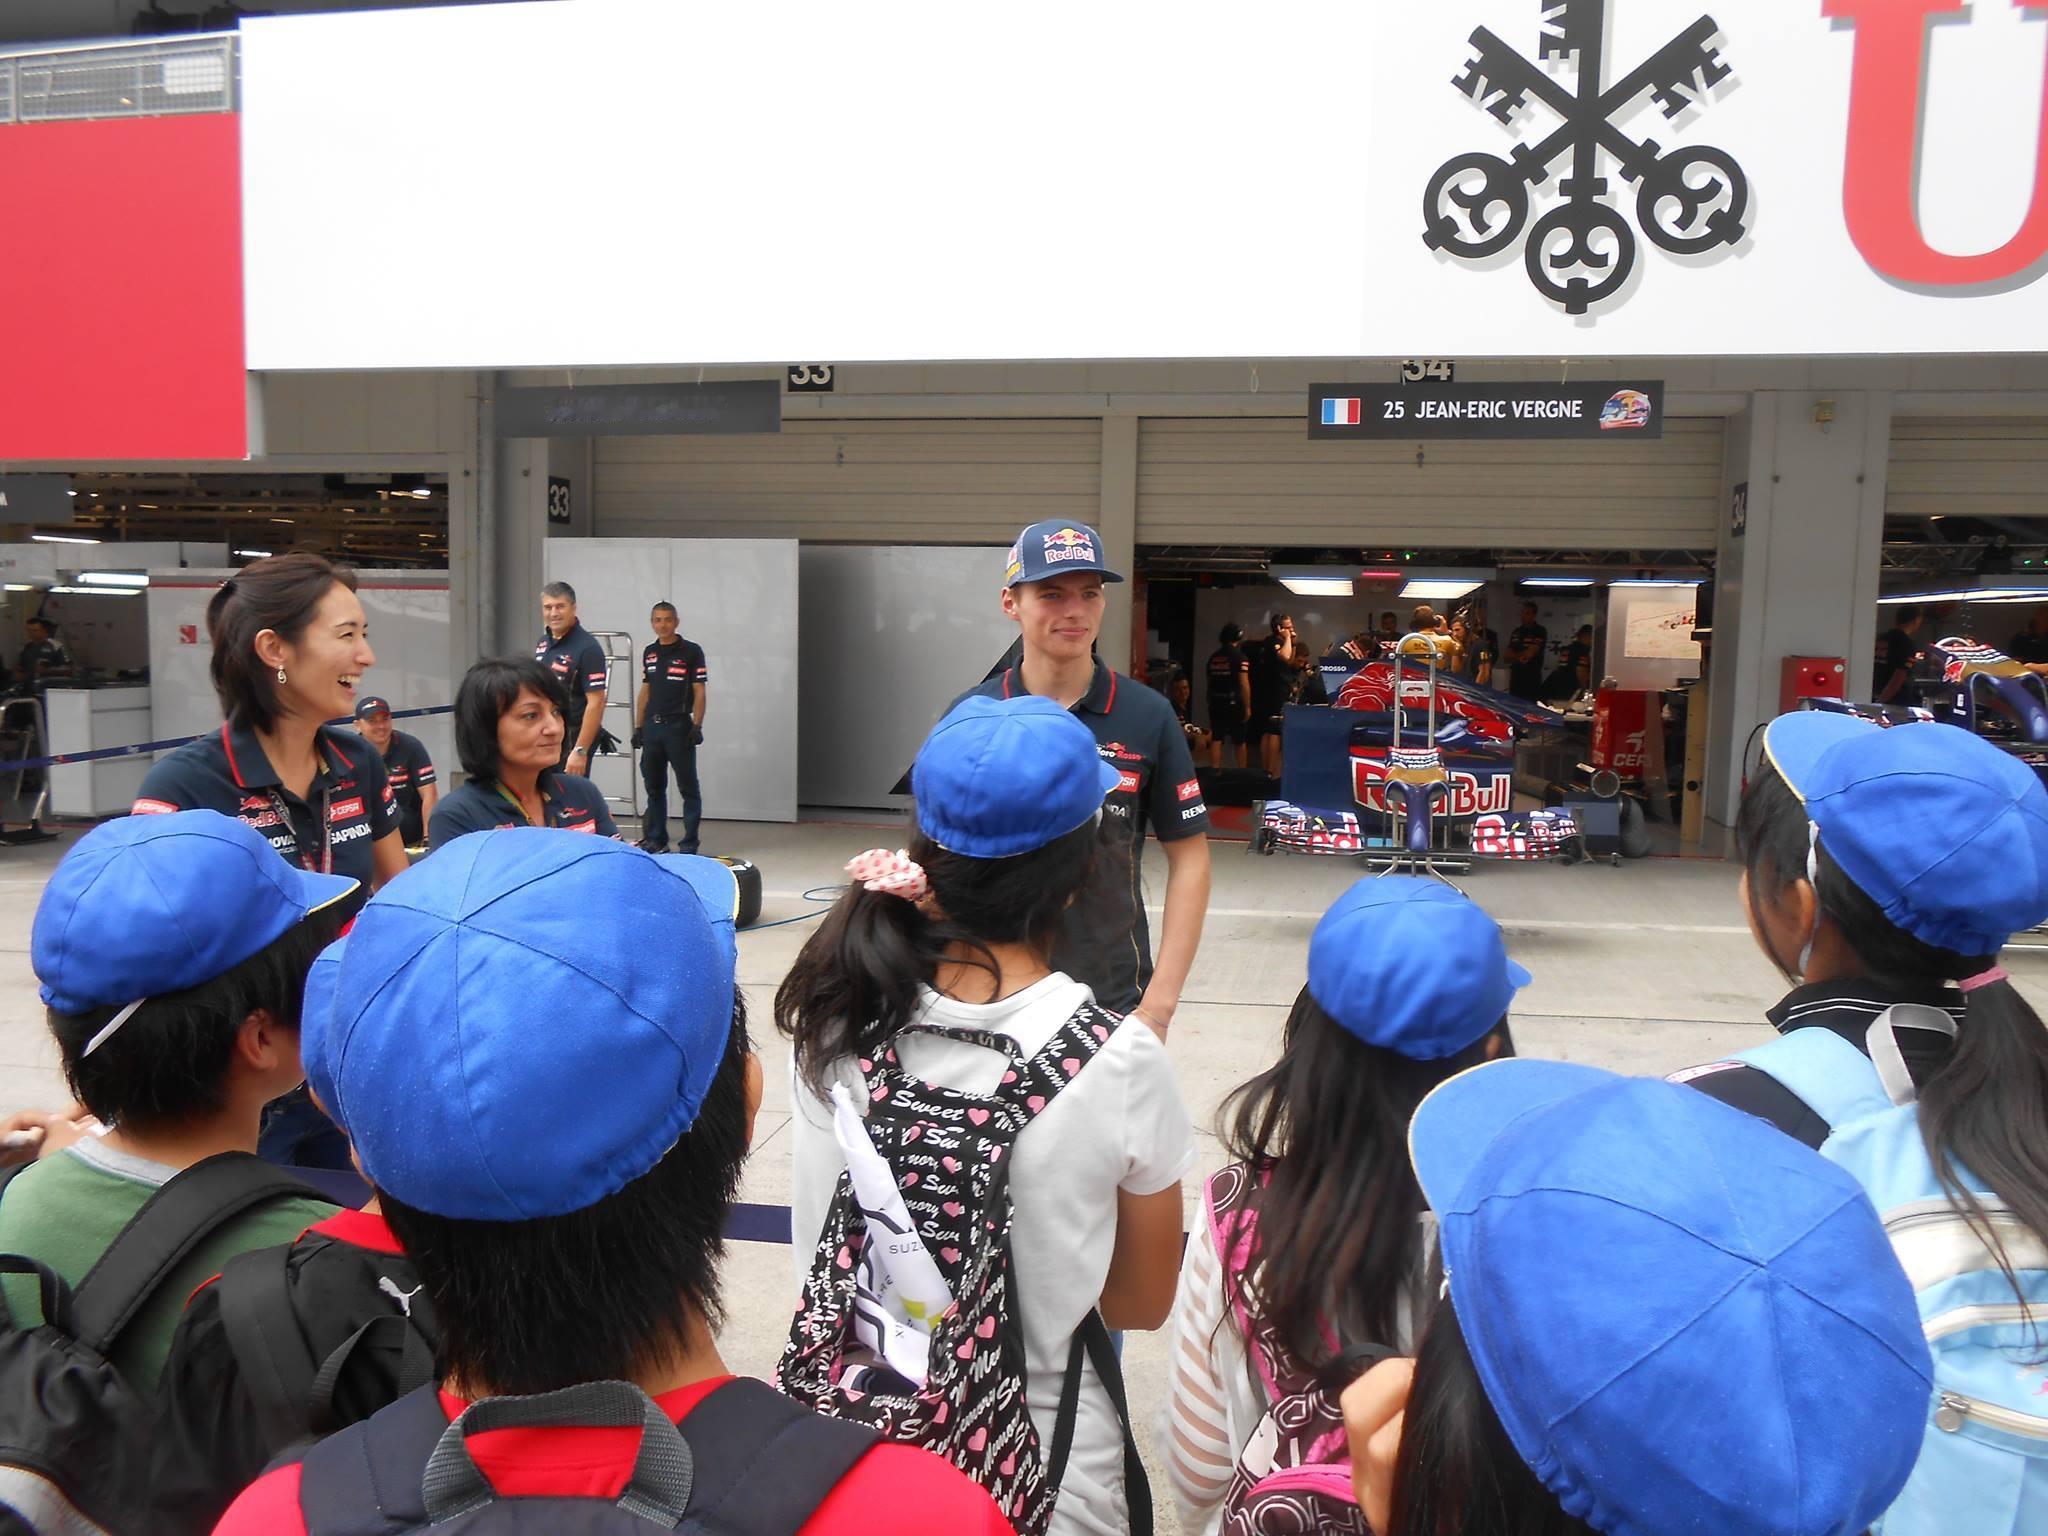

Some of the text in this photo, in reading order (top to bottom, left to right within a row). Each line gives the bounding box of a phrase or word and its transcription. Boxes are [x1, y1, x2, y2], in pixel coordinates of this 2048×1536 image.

[1384, 400, 1582, 419] 25 JEAN-ERIC VERGNE
[550, 484, 568, 517] 33
[1045, 548, 1073, 563] Red
[1452, 774, 1508, 814] Bull
[331, 823, 373, 844] SAPINDA
[891, 1089, 965, 1121] Sweet
[889, 1242, 918, 1254] SUZ
